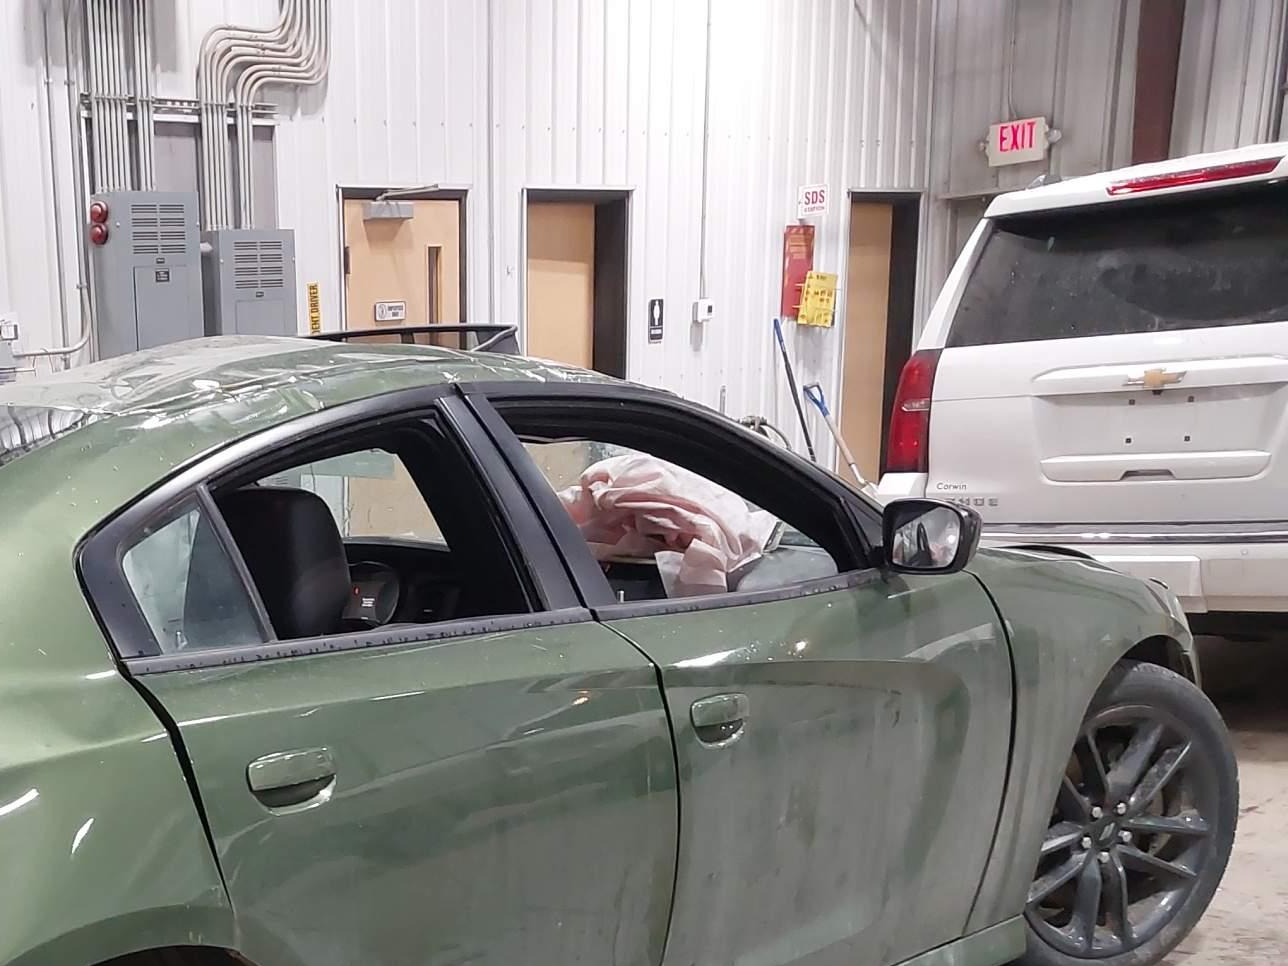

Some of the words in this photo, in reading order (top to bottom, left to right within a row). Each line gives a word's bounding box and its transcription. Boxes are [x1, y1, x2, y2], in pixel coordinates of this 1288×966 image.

[1000, 122, 1036, 152] EXIT
[804, 189, 825, 205] SDS
[936, 482, 967, 490] Corwin
